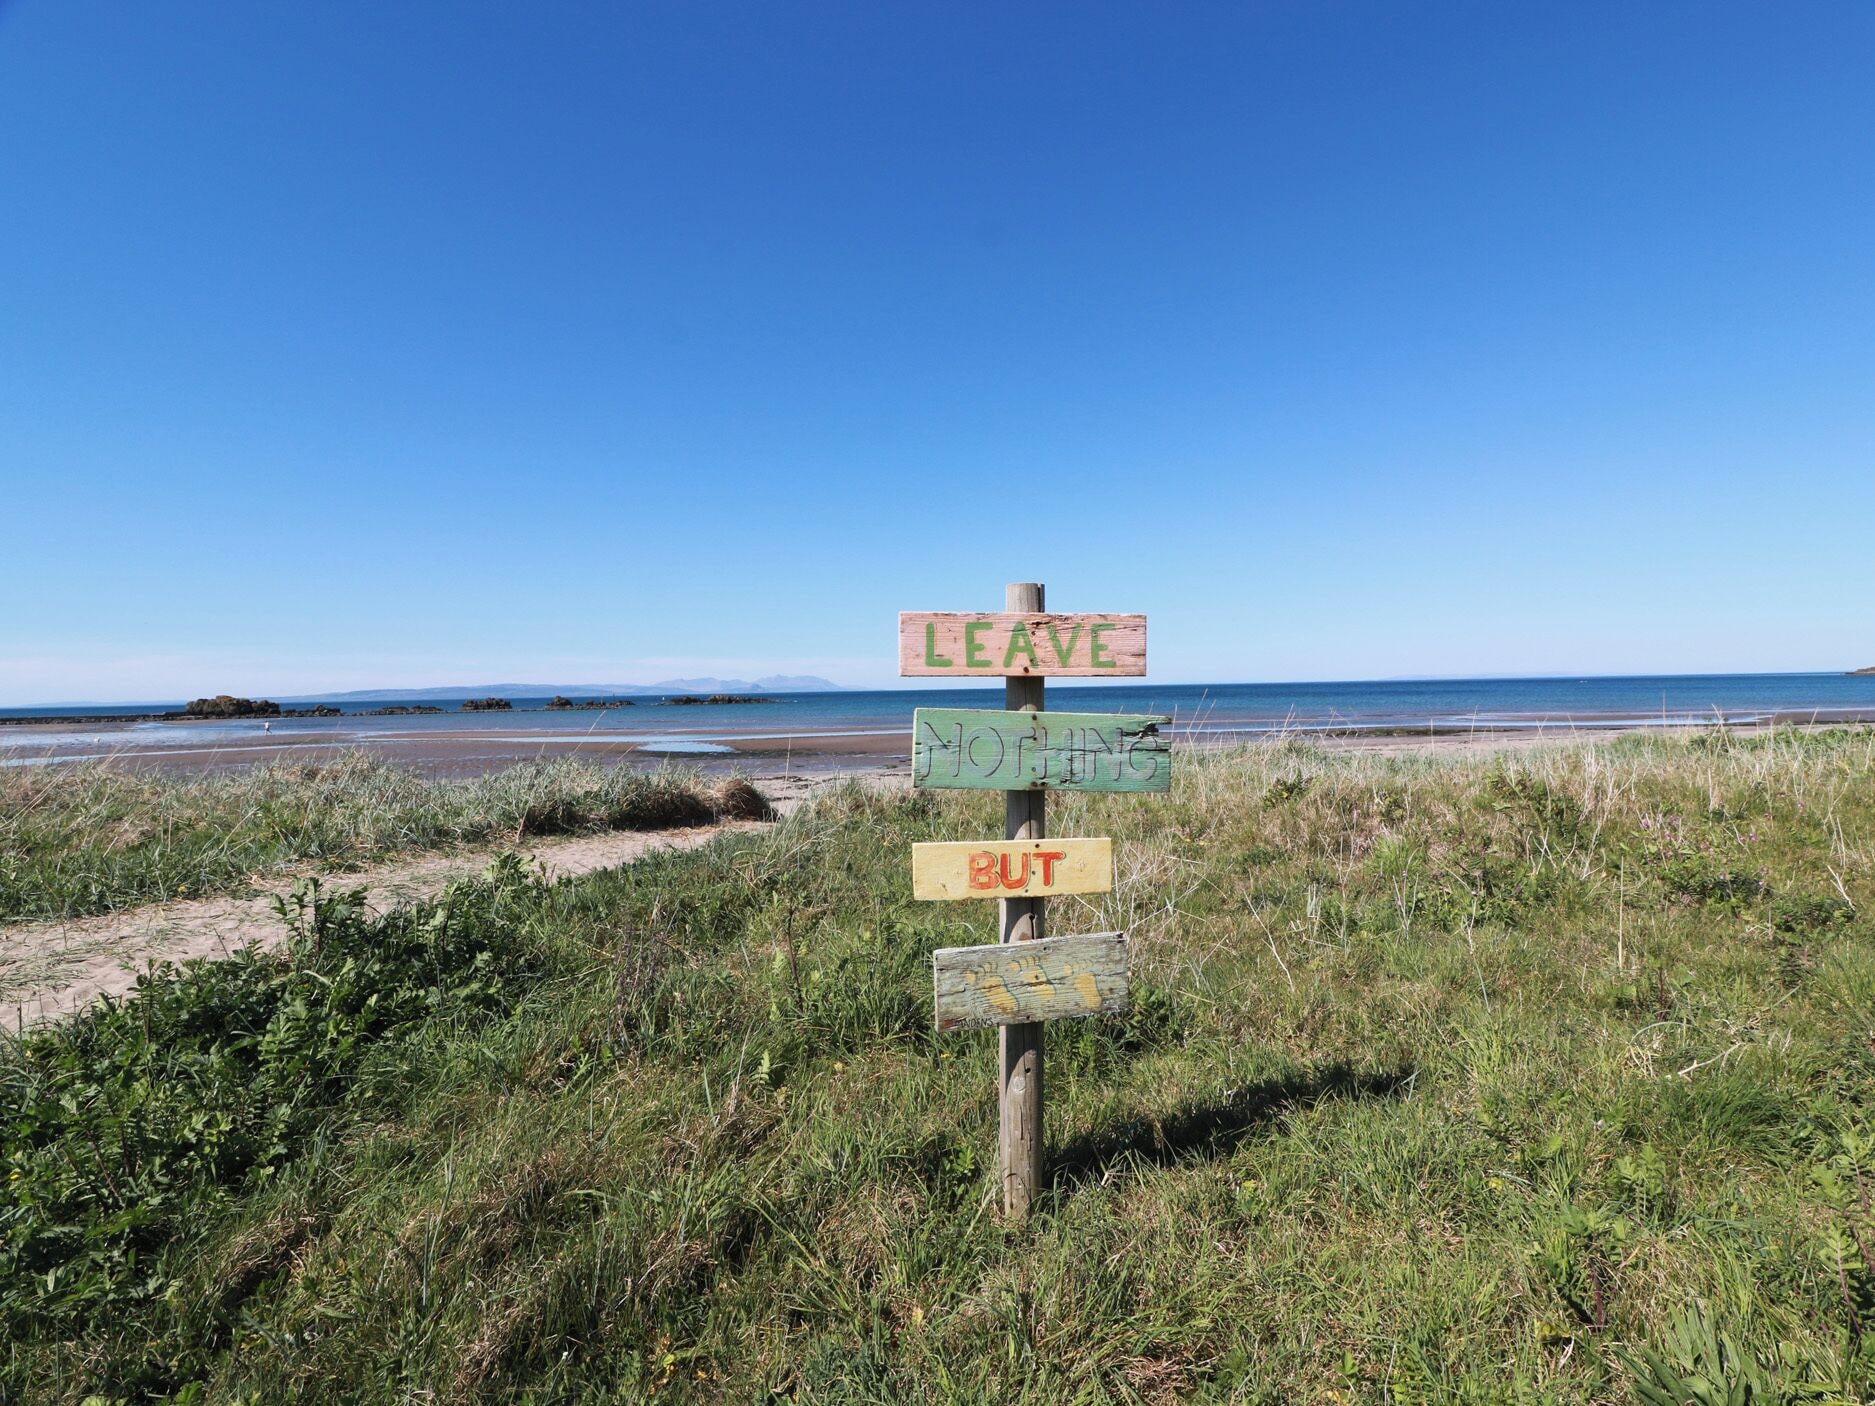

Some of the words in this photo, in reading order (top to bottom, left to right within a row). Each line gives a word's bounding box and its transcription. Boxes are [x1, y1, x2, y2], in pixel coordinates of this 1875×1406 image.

[925, 621, 1116, 669] LEAVE
[919, 721, 1160, 782] NOTHING
[968, 851, 1066, 890] BUT
